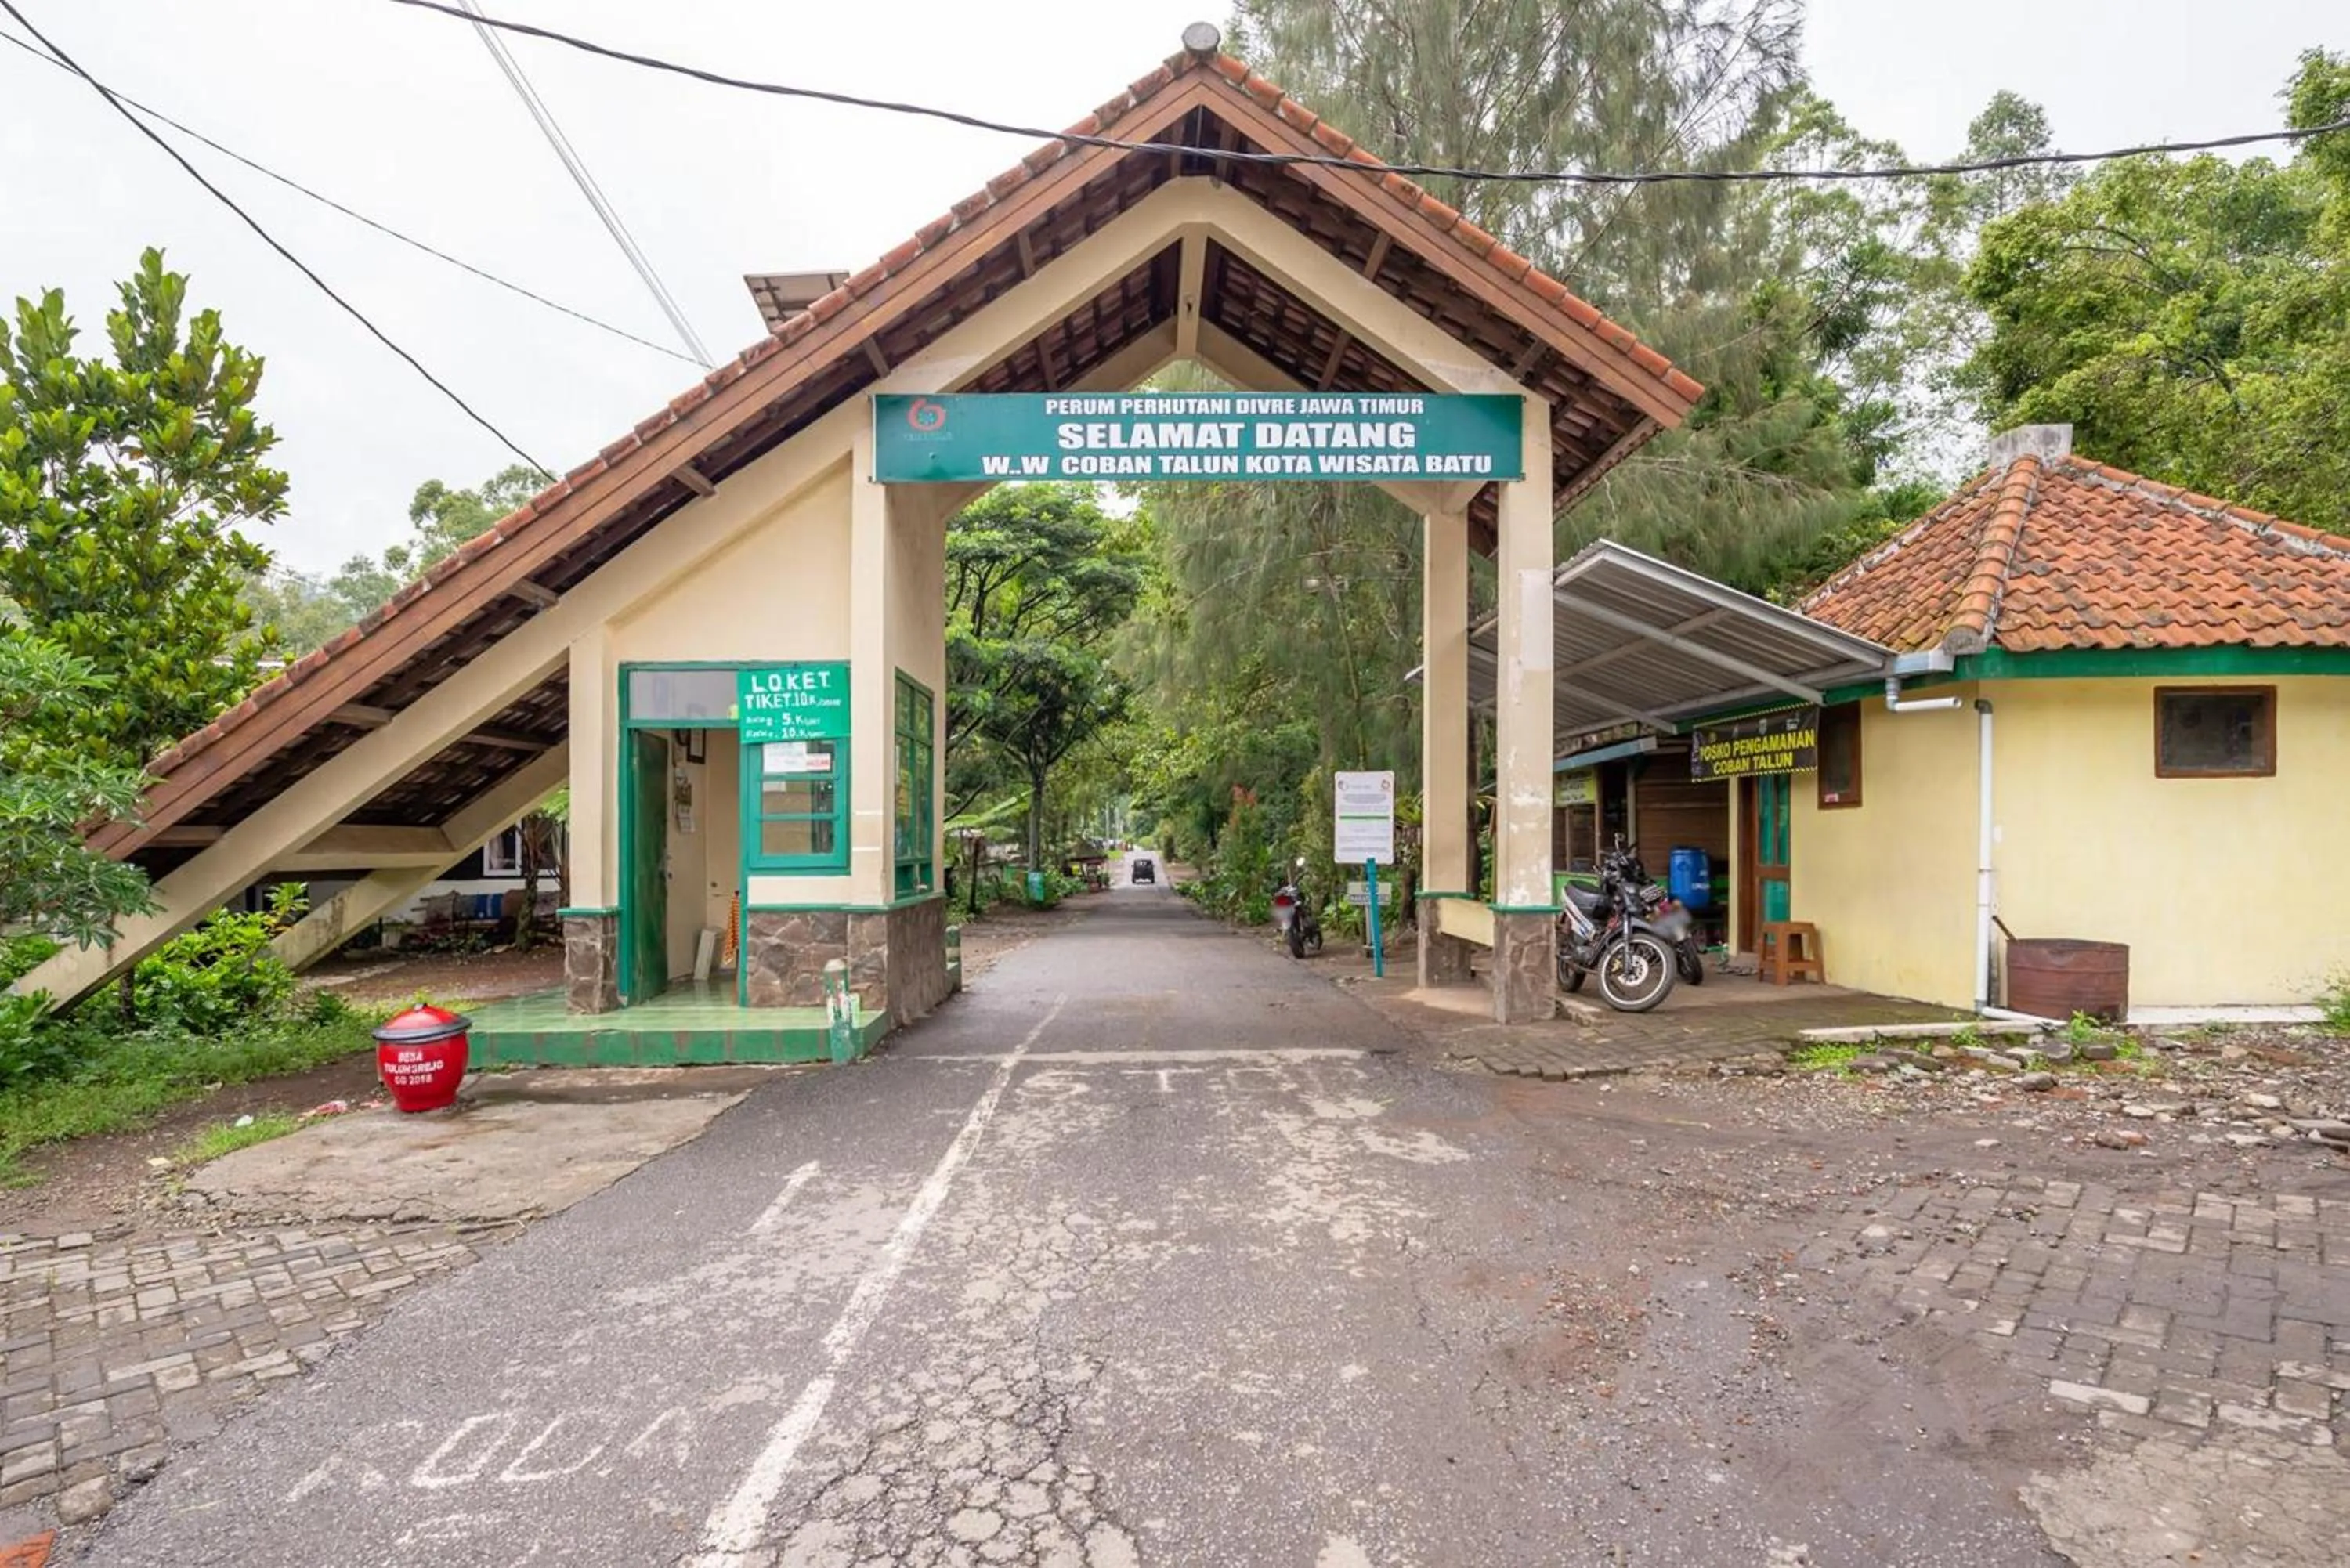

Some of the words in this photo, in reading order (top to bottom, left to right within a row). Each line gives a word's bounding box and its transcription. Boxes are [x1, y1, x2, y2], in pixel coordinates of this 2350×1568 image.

[1046, 399, 1115, 414] PERUM
[1120, 399, 1231, 414] PERHUTANI
[1235, 399, 1295, 414] DIVRE
[1299, 399, 1354, 414] JAWA
[1358, 399, 1423, 414] TIMUR
[1058, 422, 1245, 450] SELAMAT
[1255, 421, 1416, 449] DATANG
[1061, 456, 1152, 475] COBAN
[1158, 455, 1238, 474] TALUN
[1246, 455, 1313, 474] KOTA
[1318, 455, 1419, 473] WISATA
[1425, 454, 1492, 473] BATU
[751, 671, 832, 693] LOKET
[1732, 728, 1815, 757] PENGAMANAN
[1713, 757, 1749, 775] COBAN
[1752, 752, 1794, 769] TALUN
